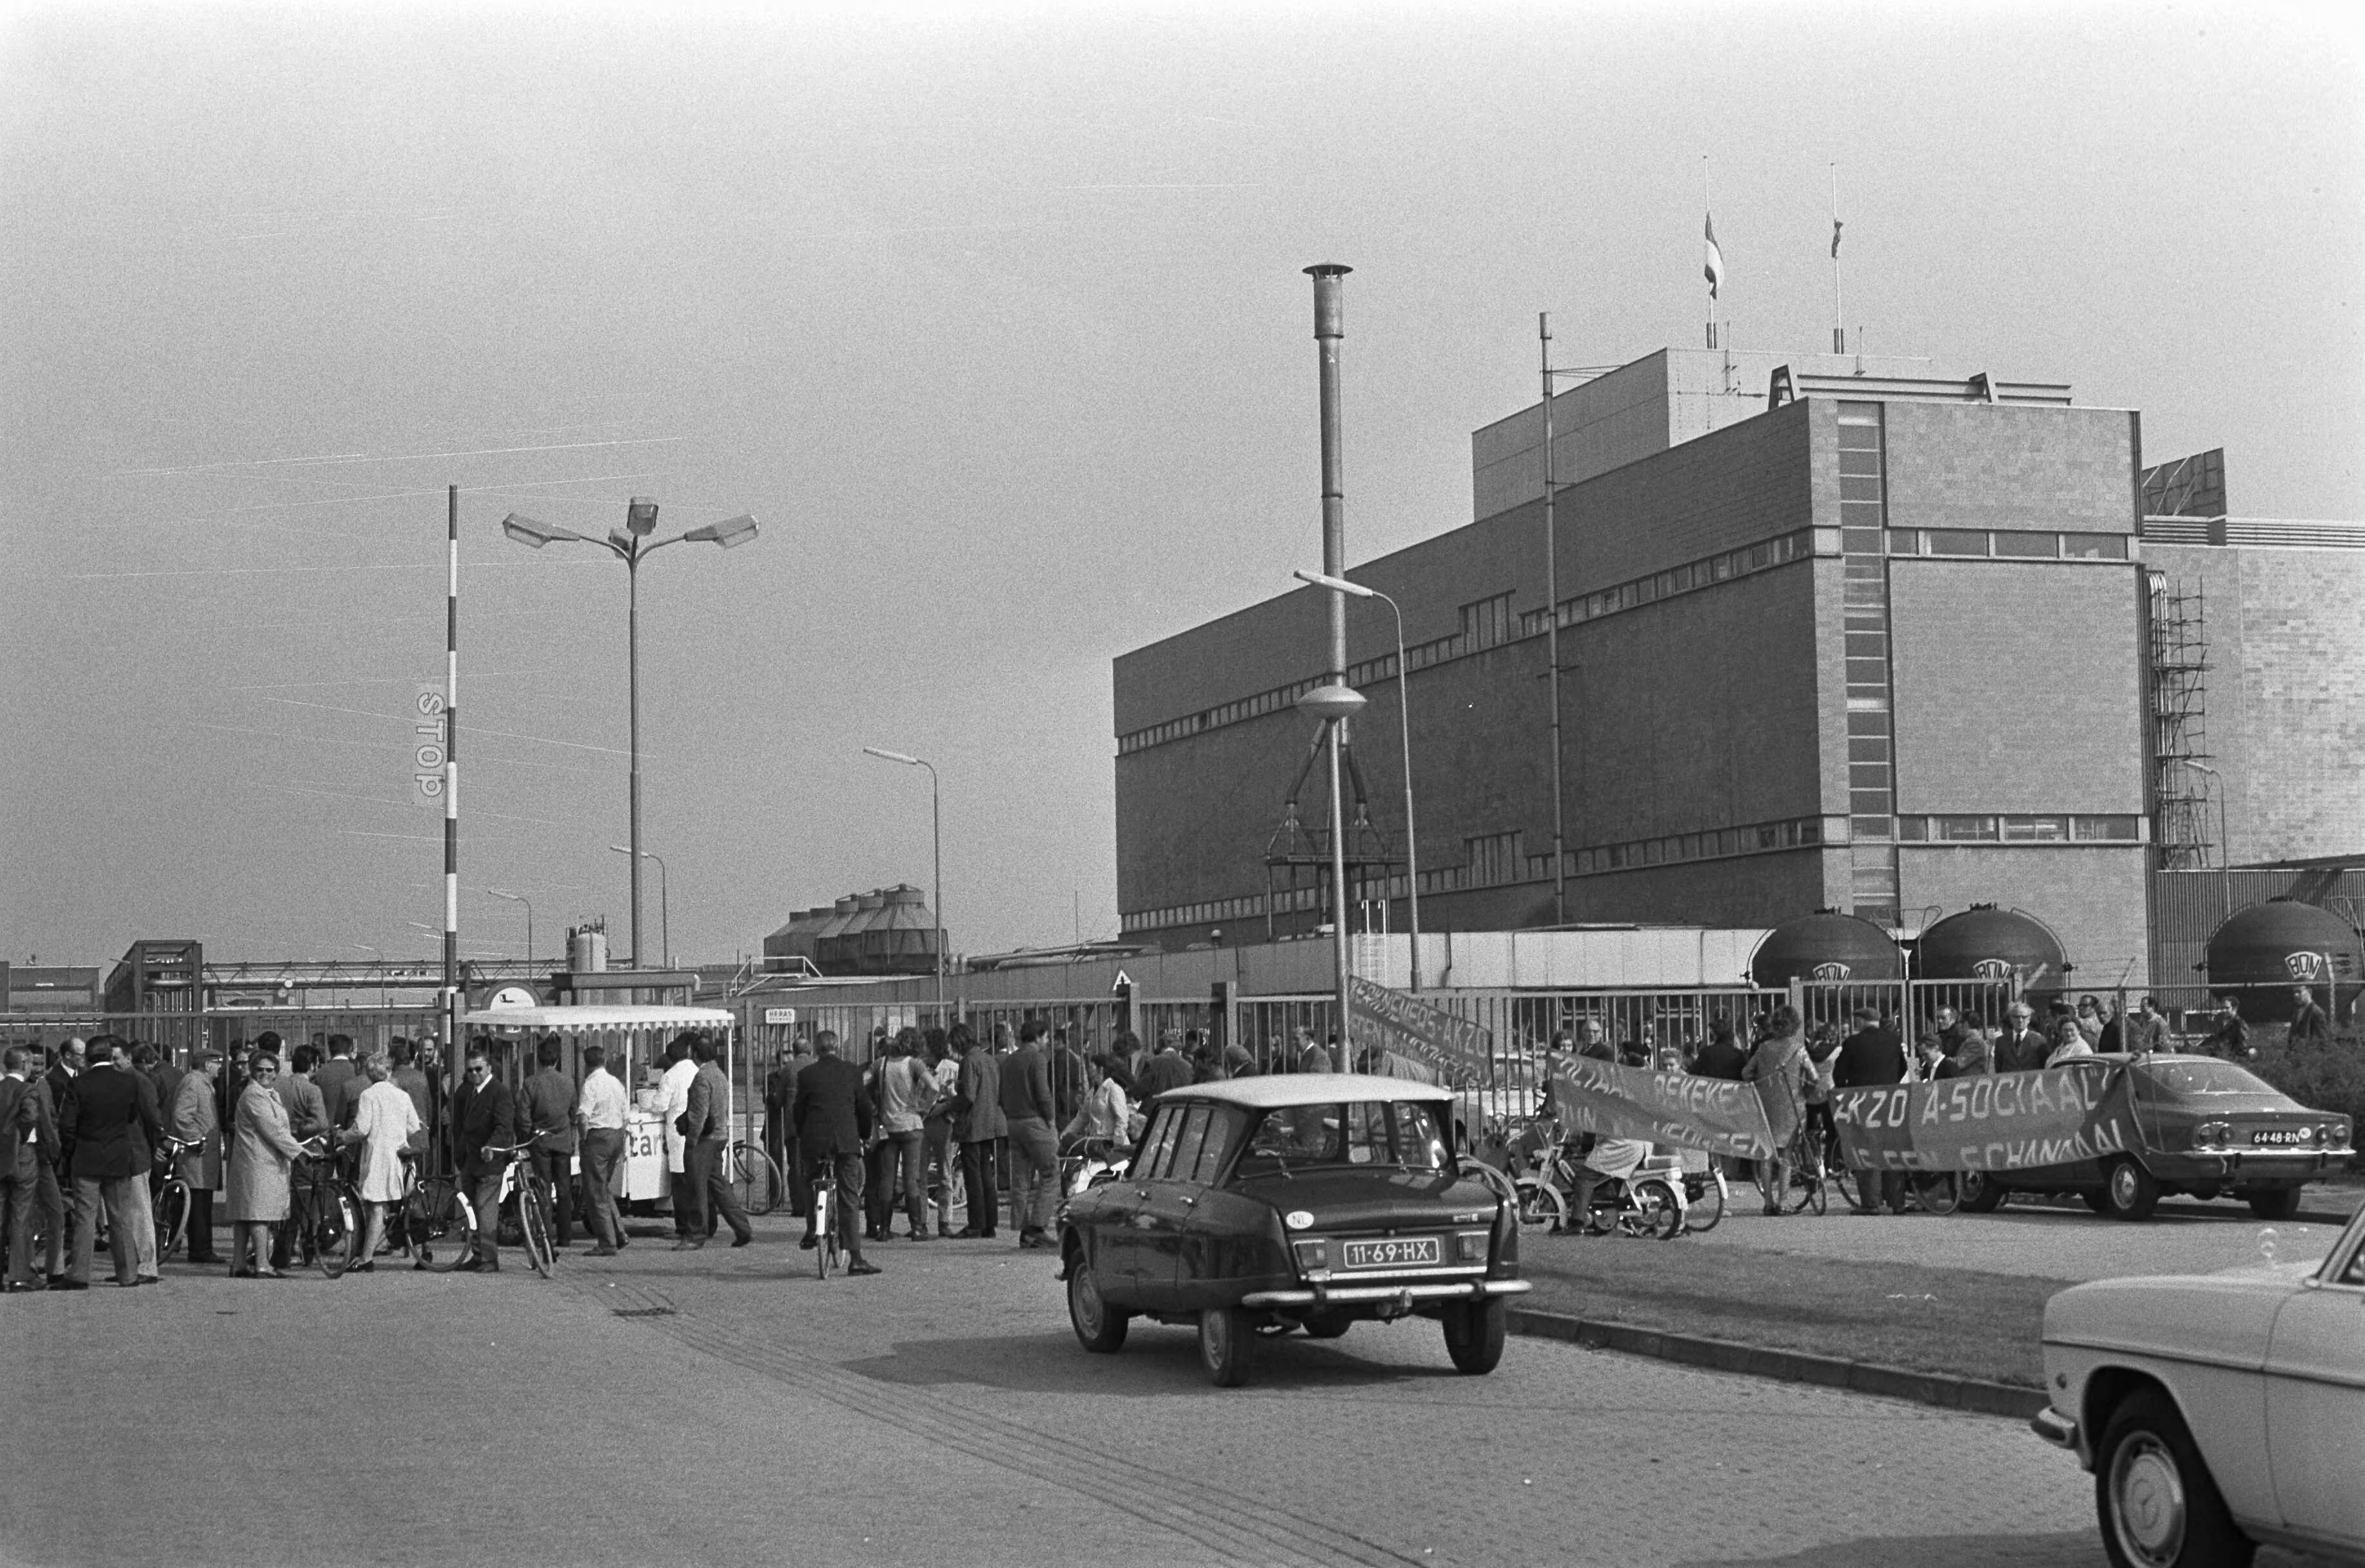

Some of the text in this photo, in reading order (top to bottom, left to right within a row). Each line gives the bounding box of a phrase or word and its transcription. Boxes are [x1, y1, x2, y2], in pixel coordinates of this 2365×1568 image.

[415, 692, 445, 798] STOP
[1444, 1017, 1488, 1057] AKZO
[1834, 1088, 1908, 1128] AKZO
[1352, 1242, 1429, 1264] 11-69-HX
